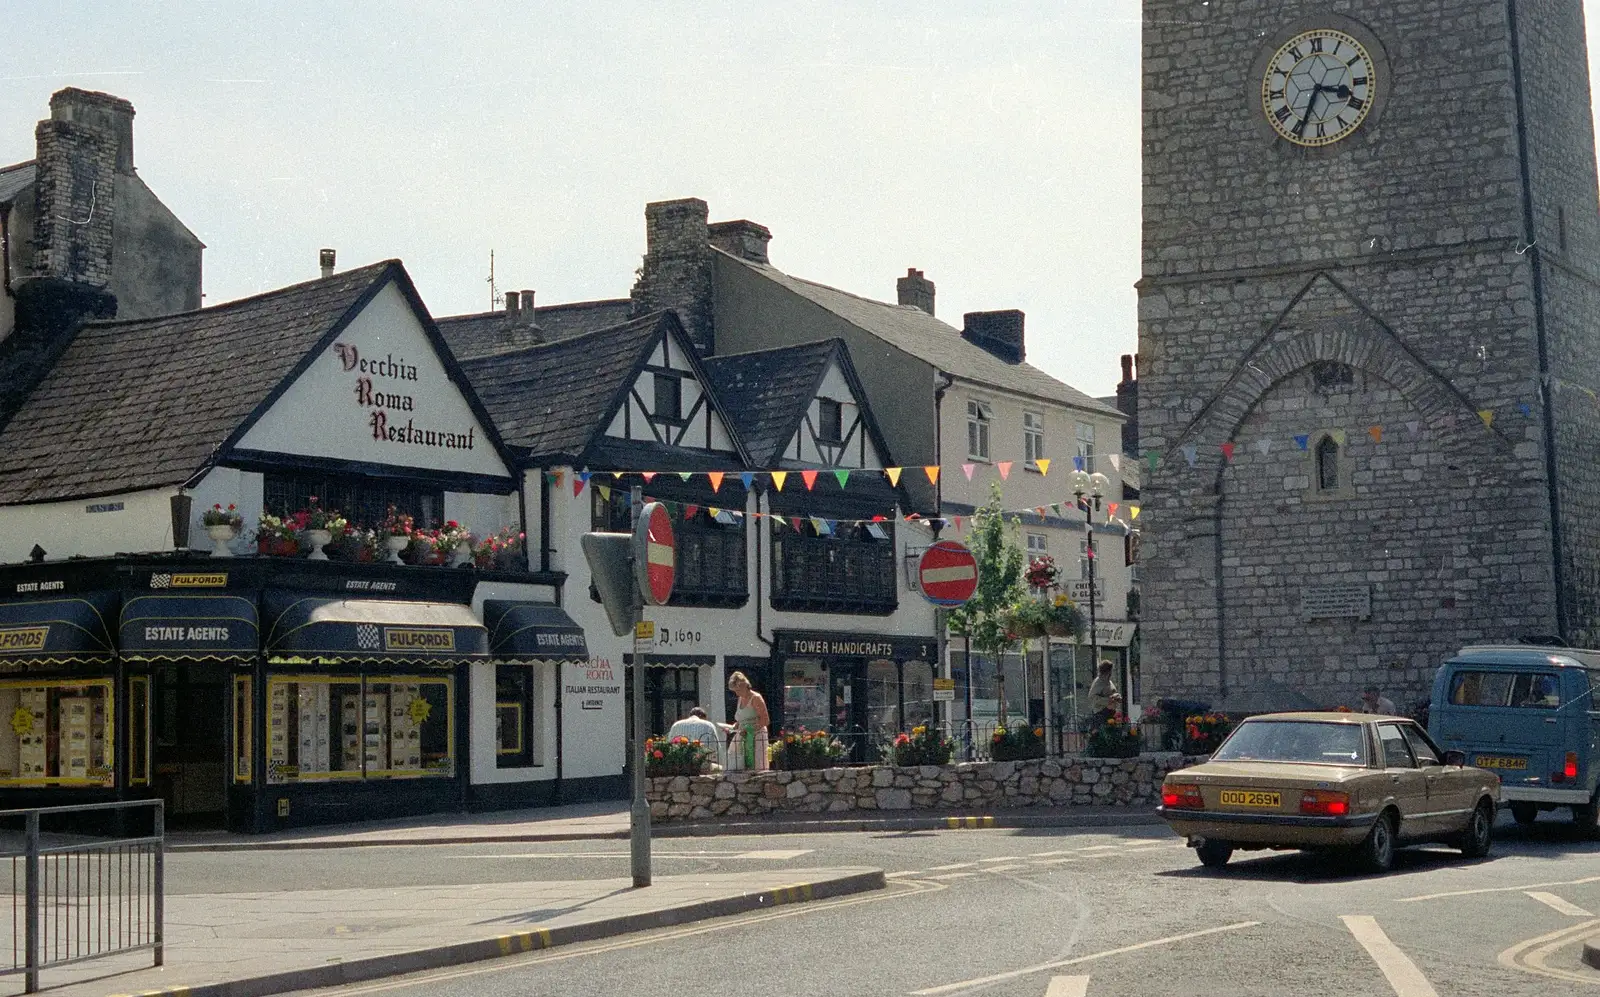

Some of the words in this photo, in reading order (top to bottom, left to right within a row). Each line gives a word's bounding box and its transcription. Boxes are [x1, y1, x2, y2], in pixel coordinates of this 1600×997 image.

[334, 342, 418, 382] Vecchia
[353, 377, 414, 412] Roma
[368, 411, 475, 451] Restaurant
[17, 582, 38, 593] ESTATE
[40, 580, 65, 591] AGENTS
[173, 575, 225, 585] FULFORDS
[346, 580, 370, 590] ESTATE
[370, 581, 397, 591] AGENTS
[1080, 590, 1101, 598] GLSS
[145, 627, 185, 641] ESTATE
[187, 627, 229, 641] AGENTS
[389, 632, 450, 647] FULFORDS
[536, 633, 560, 646] ESTATE
[560, 633, 586, 647] AGENTS
[675, 628, 701, 646] 1690
[794, 640, 829, 653] TOWER
[831, 641, 892, 656] HANDICRAFTS
[921, 645, 927, 657] 3
[565, 685, 586, 694] ITALIAN
[587, 686, 620, 695] RESTAURANT
[1248, 793, 1280, 806] 269W
